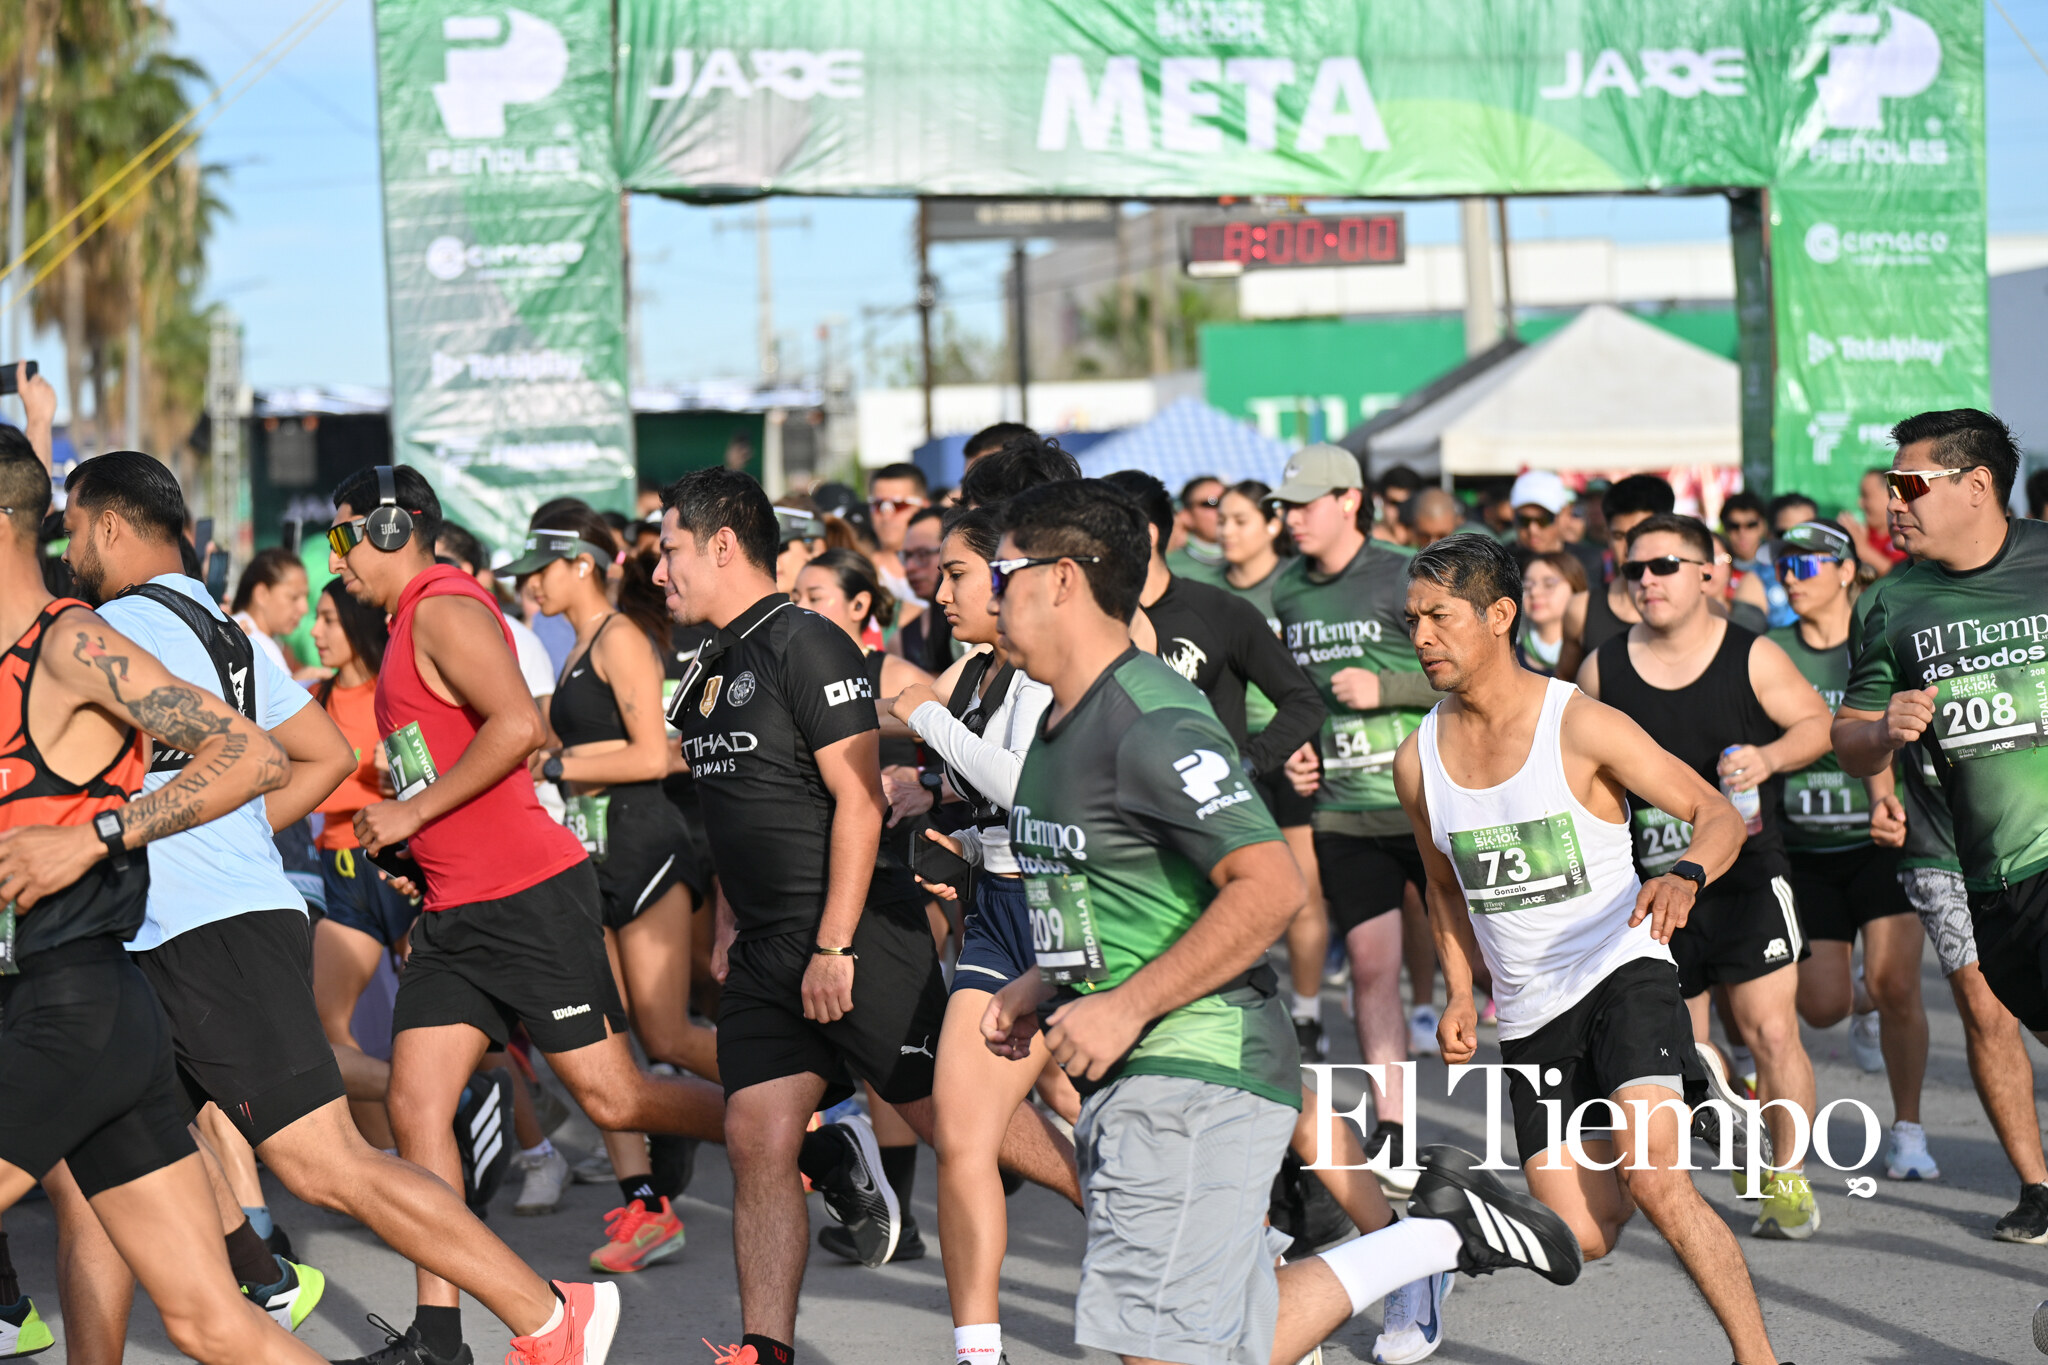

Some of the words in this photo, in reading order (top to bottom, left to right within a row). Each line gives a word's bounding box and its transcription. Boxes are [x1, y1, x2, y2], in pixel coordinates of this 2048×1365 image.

[1037, 54, 1391, 151] META
[381, 523, 400, 535] JBL
[1287, 620, 1302, 649] El
[1304, 619, 1382, 644] Tiempo
[1911, 625, 1946, 663] El
[1947, 613, 2048, 651] Tiemp
[1310, 644, 1364, 663] todos
[1923, 663, 1954, 682] de
[1957, 645, 2046, 673] todos
[1950, 673, 1996, 686] CARRERA
[2030, 667, 2045, 677] 208
[1942, 692, 2017, 736] 208
[406, 726, 418, 737] 107
[681, 731, 758, 761] TIHAD
[1335, 730, 1371, 759] 54
[385, 754, 408, 794] 07
[692, 758, 736, 780] IRWAYS
[1798, 788, 1851, 814] 111
[1013, 804, 1087, 860] Tiempo
[1472, 825, 1519, 838] CARRERA
[1556, 818, 1568, 828] 73
[1478, 847, 1531, 886] 73
[1561, 831, 1583, 885] MEDALLA
[1494, 885, 1527, 896] Gonzalo
[1029, 907, 1064, 951] 209
[1076, 898, 1102, 968] MEDALLA
[553, 1003, 591, 1021] Wilson
